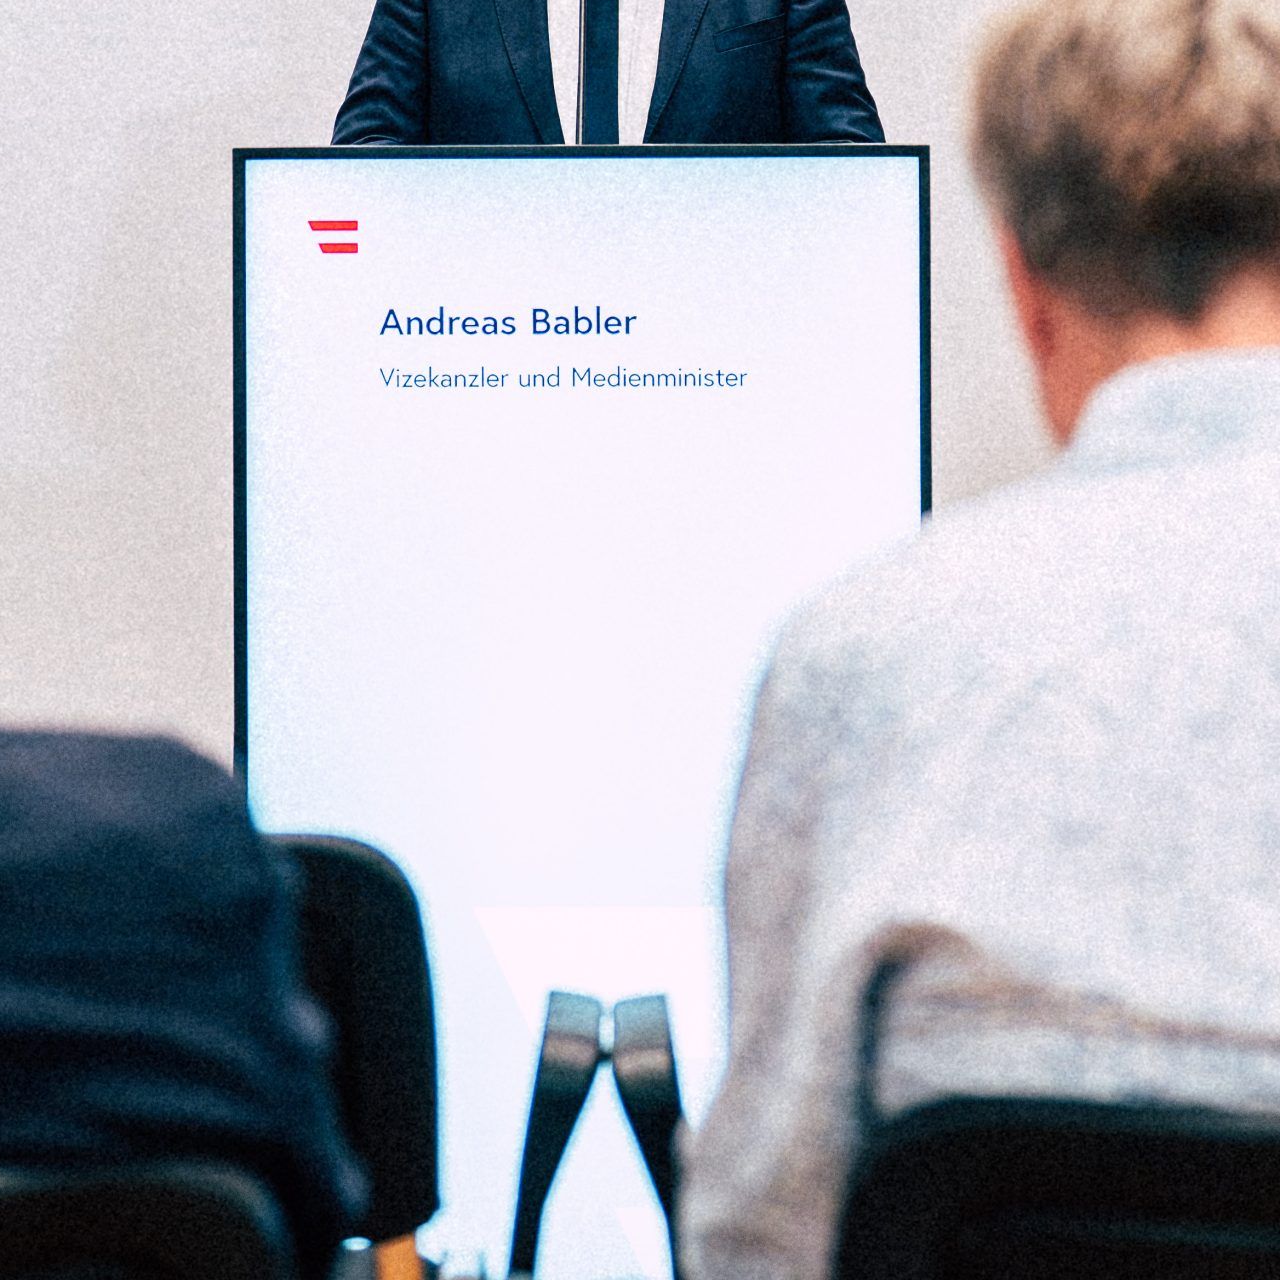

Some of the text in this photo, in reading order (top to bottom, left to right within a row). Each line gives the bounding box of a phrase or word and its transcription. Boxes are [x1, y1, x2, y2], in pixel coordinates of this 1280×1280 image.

[379, 305, 638, 336] Andreas Babler
[379, 365, 748, 389] Vizekanzler und Medienminister
